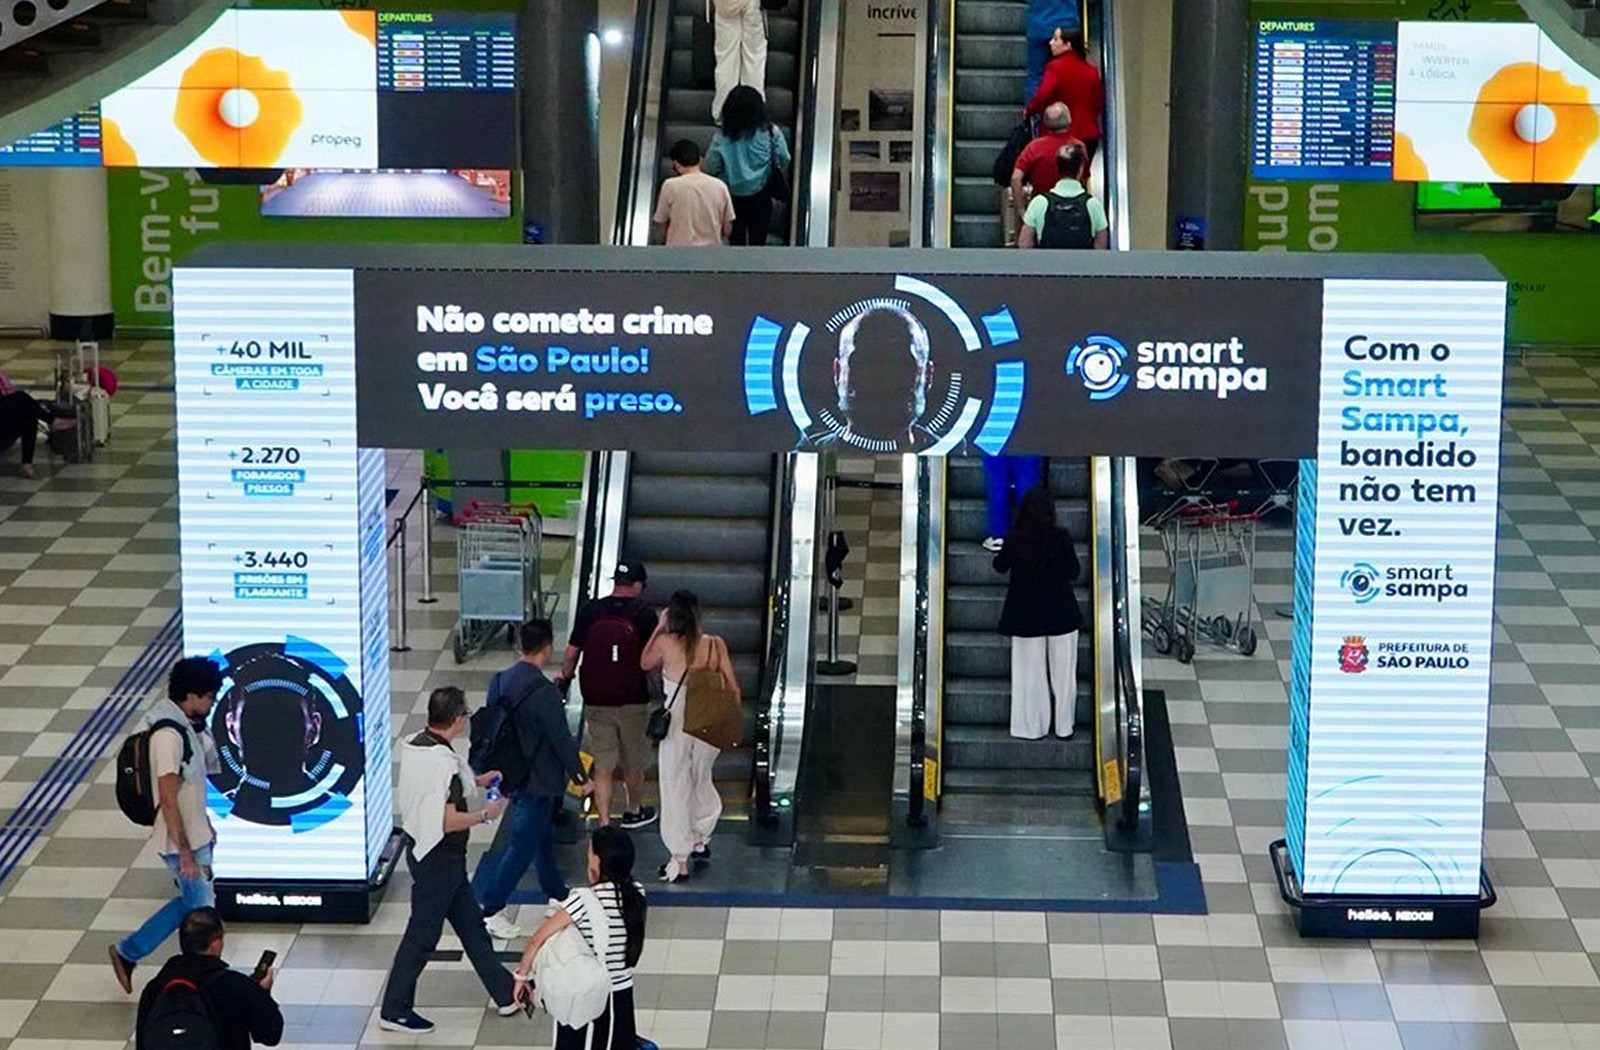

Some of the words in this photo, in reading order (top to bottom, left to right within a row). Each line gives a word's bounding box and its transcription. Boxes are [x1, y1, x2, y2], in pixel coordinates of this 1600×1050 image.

[378, 13, 433, 22] DEPARTURES
[1260, 21, 1315, 31] DEPARTURES
[311, 134, 362, 149] propeg
[416, 305, 485, 333] Não
[492, 308, 615, 334] cometa
[622, 306, 714, 335] crime
[269, 341, 312, 359] MIL
[1137, 337, 1244, 364] smart
[1344, 335, 1420, 361] Com
[1430, 343, 1451, 361] o
[416, 350, 468, 372] em
[476, 345, 540, 373] São
[547, 346, 649, 373] Paulo!
[270, 365, 286, 376] EM
[287, 365, 320, 376] TODA
[241, 379, 250, 389] A
[252, 379, 295, 389] CIDADE
[1136, 366, 1267, 399] sampa
[1342, 369, 1447, 397] Smart
[416, 382, 499, 411] Você
[505, 384, 577, 411] será
[585, 391, 683, 418] preso.
[1341, 406, 1468, 439] Sampa,
[1340, 440, 1477, 467] bandido
[1339, 476, 1401, 502] não
[1411, 479, 1476, 503] tem
[1338, 517, 1401, 536] vez.
[286, 574, 303, 584] EM
[1386, 564, 1454, 580] smart
[239, 587, 305, 598] FLAGRANTE
[1385, 583, 1468, 602] sampa
[1378, 642, 1450, 653] PREFEITURA
[1453, 643, 1469, 653] DE
[1377, 653, 1412, 668] SÃO
[1415, 656, 1469, 669] PAULO
